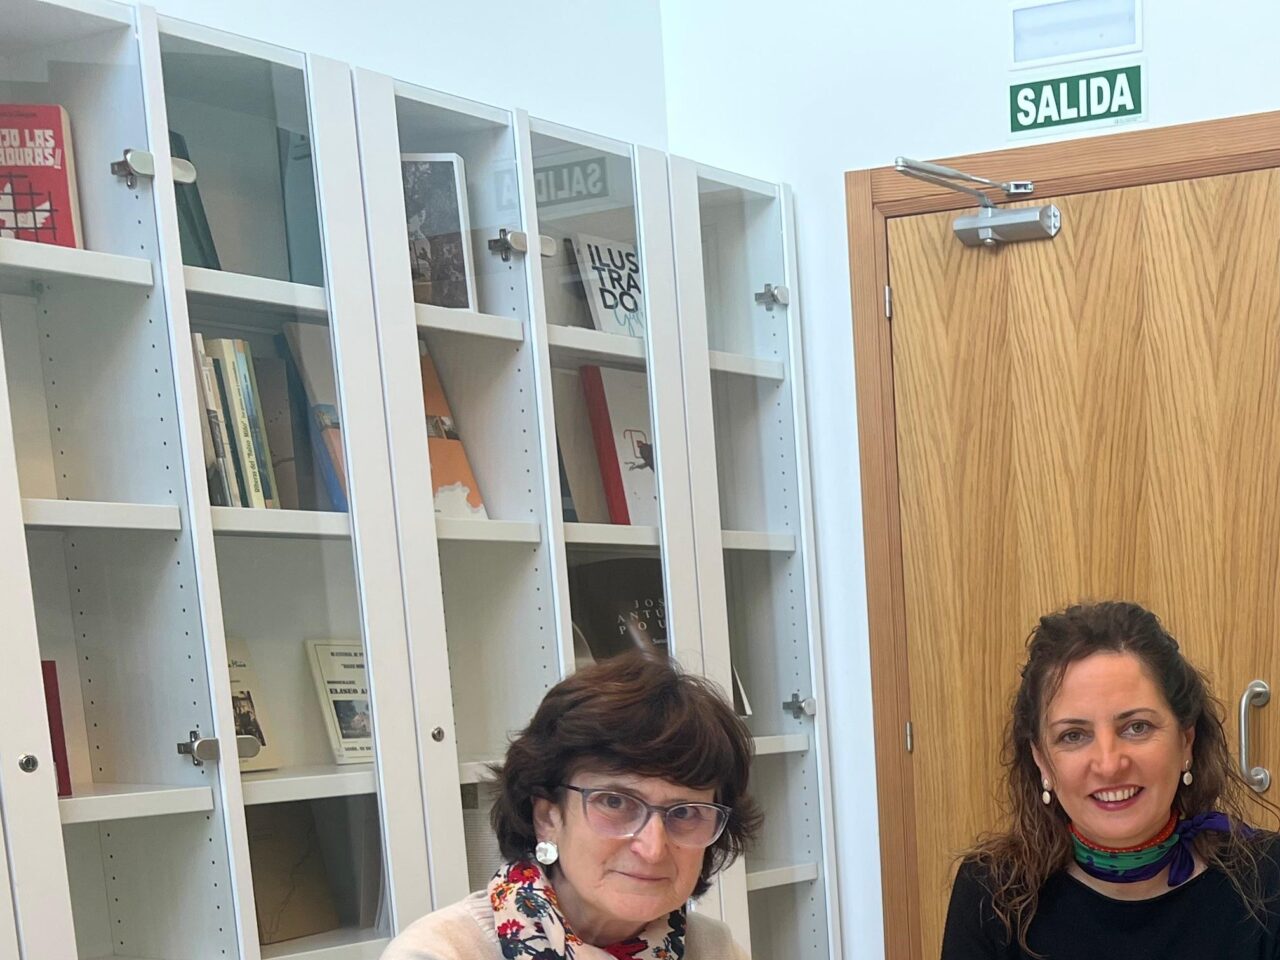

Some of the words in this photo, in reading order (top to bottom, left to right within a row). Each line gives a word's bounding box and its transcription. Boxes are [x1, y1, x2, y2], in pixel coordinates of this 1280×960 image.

[1016, 72, 1135, 126] SALIDA
[0, 129, 20, 147] JO
[24, 129, 55, 148] LAS
[587, 244, 639, 274] ILUS
[592, 266, 641, 294] TRA
[599, 288, 638, 313] DO
